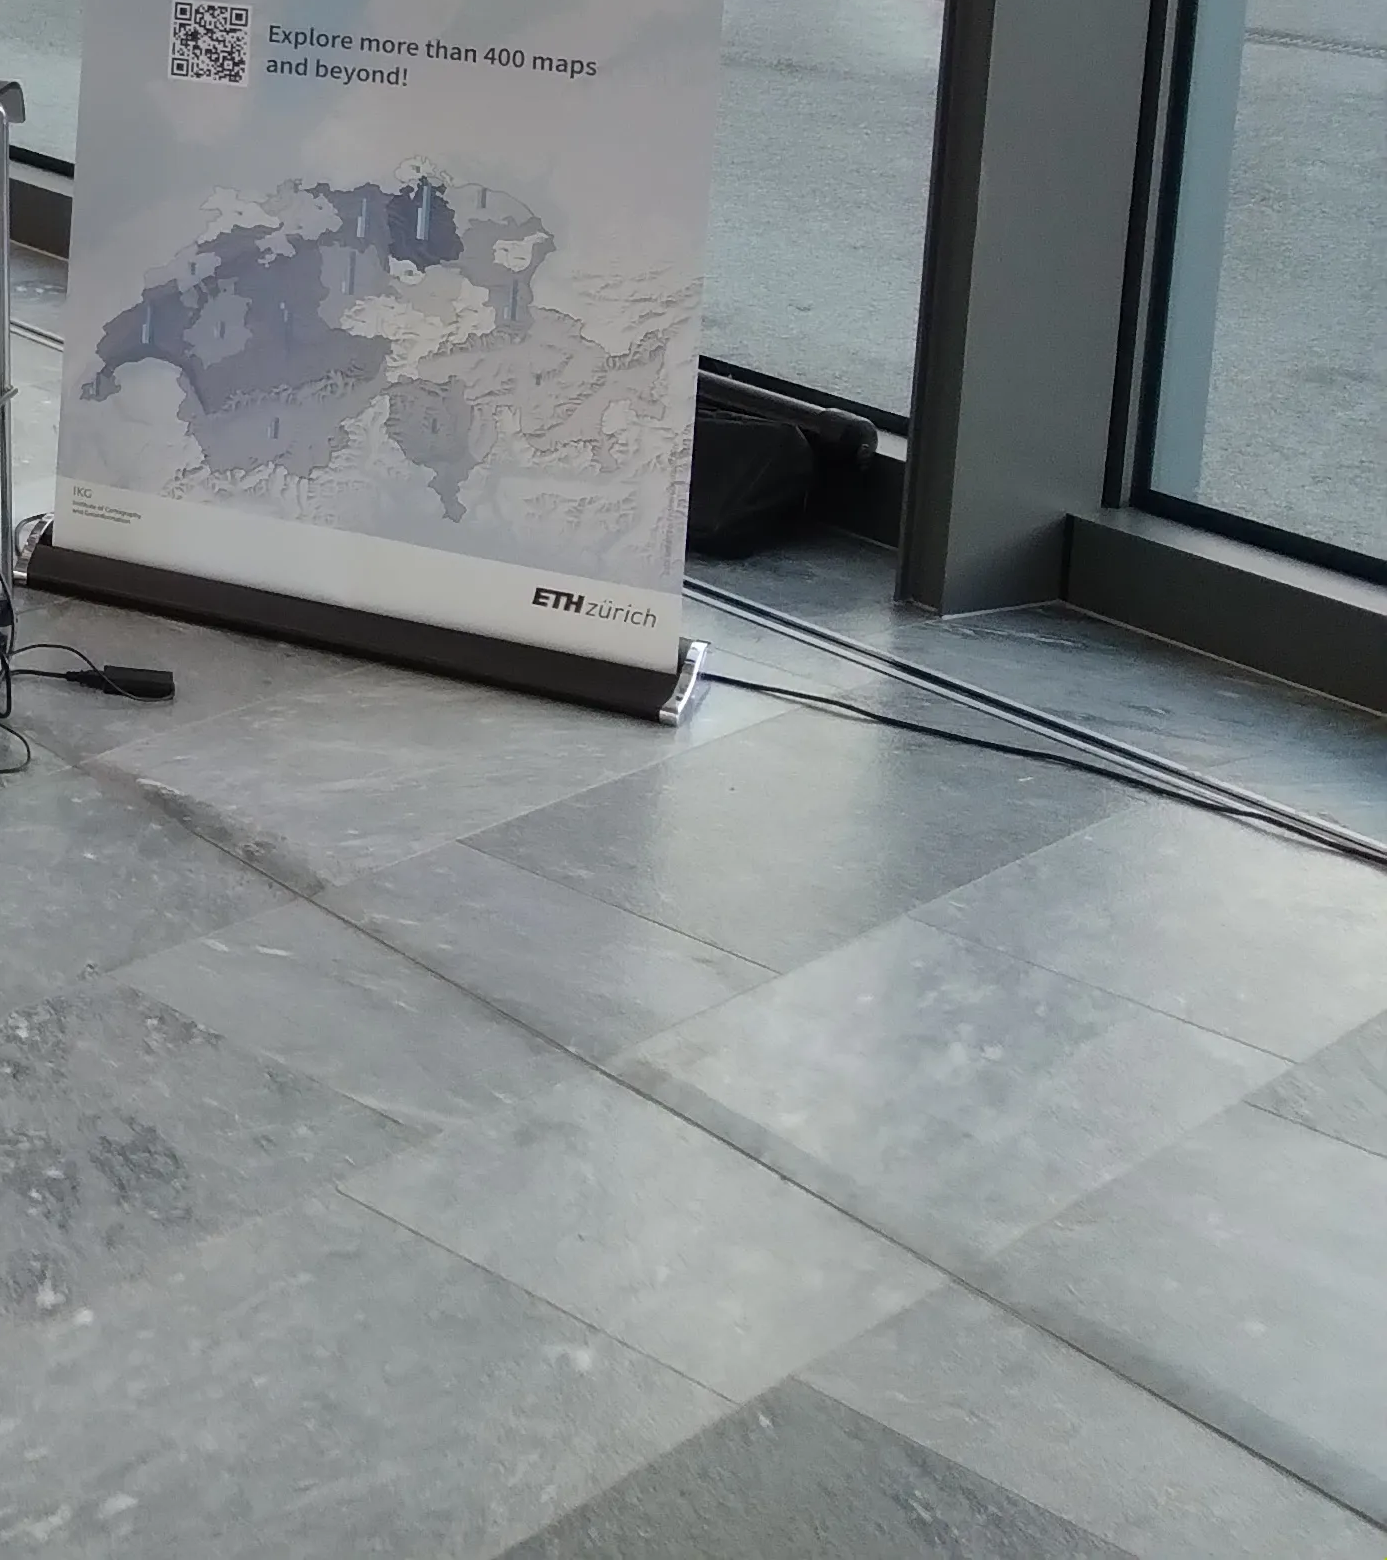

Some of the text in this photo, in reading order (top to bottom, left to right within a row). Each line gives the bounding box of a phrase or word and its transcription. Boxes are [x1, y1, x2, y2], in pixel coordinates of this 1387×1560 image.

[267, 23, 599, 80] Explore more than 400 maps
[265, 55, 411, 88] and beyond!
[72, 485, 93, 499] IKG
